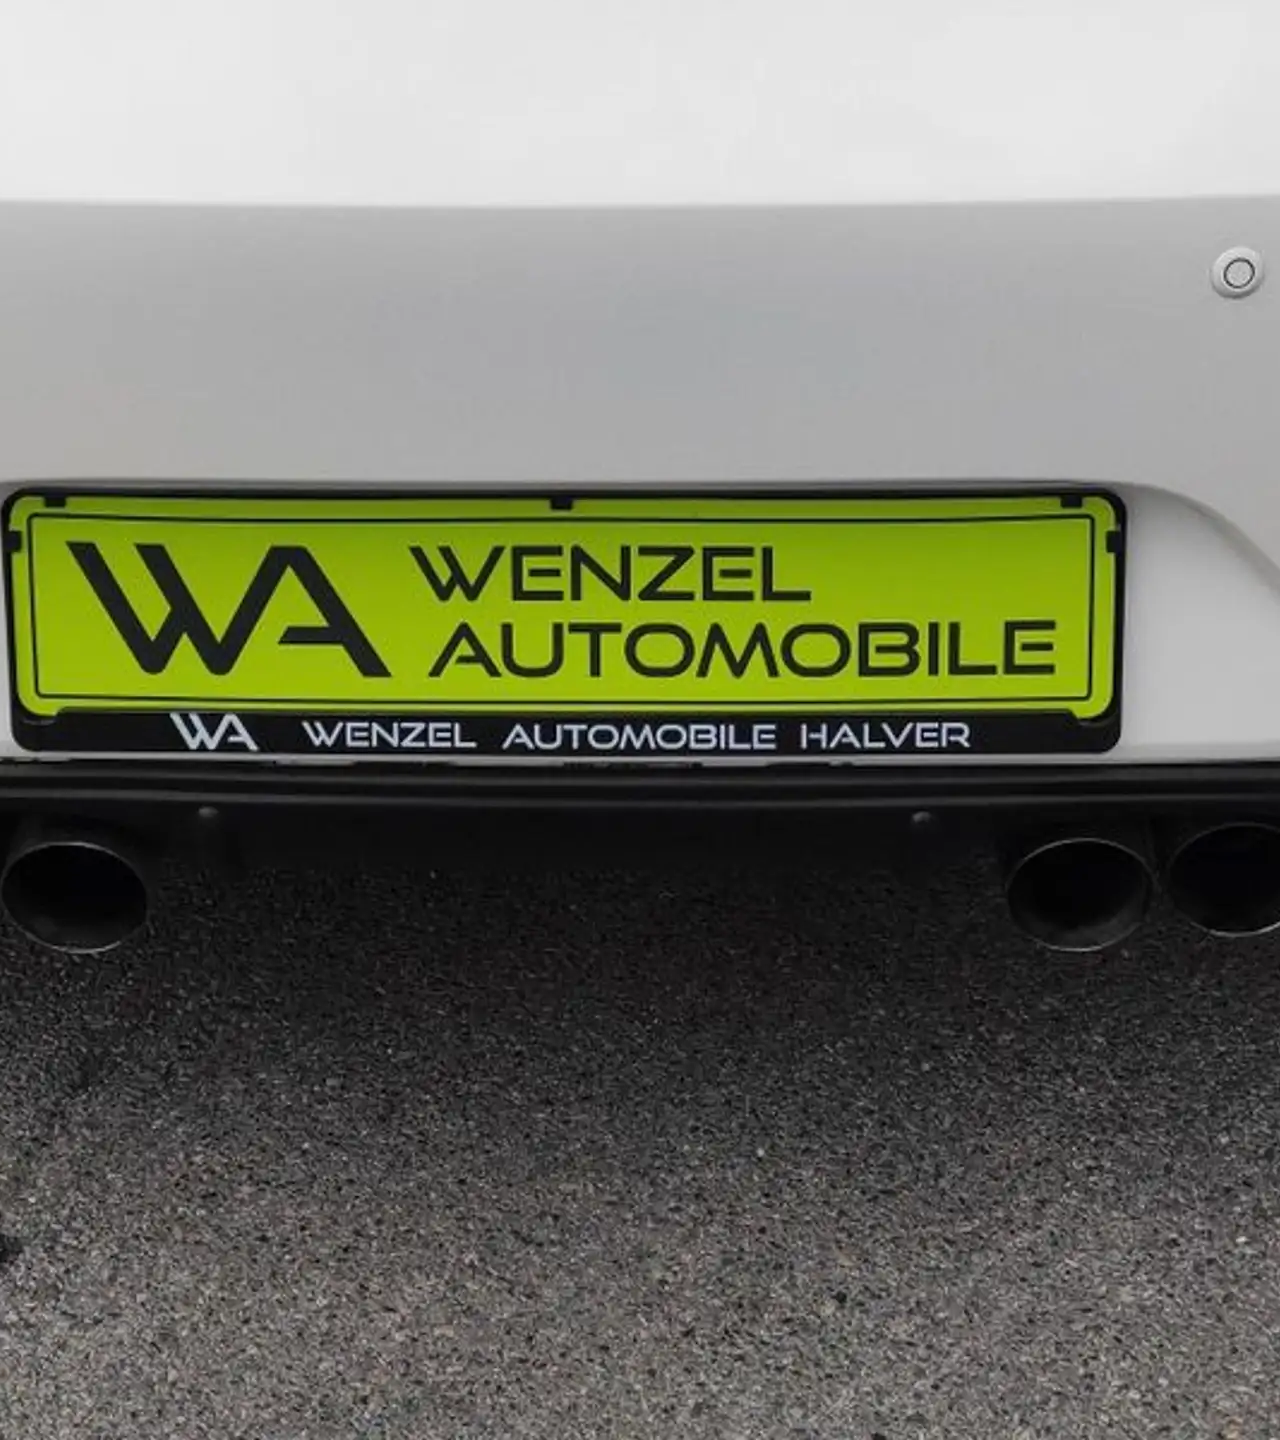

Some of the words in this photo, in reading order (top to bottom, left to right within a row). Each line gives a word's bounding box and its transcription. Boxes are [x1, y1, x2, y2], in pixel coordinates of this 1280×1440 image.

[408, 543, 812, 603] WENZEL
[65, 540, 392, 678] WA
[428, 619, 1057, 679] AUTOMOBILE
[170, 712, 258, 752] WA
[302, 721, 477, 748] WENZEL
[501, 721, 777, 750] AUTOMOBILE
[800, 721, 970, 749] HALVER
